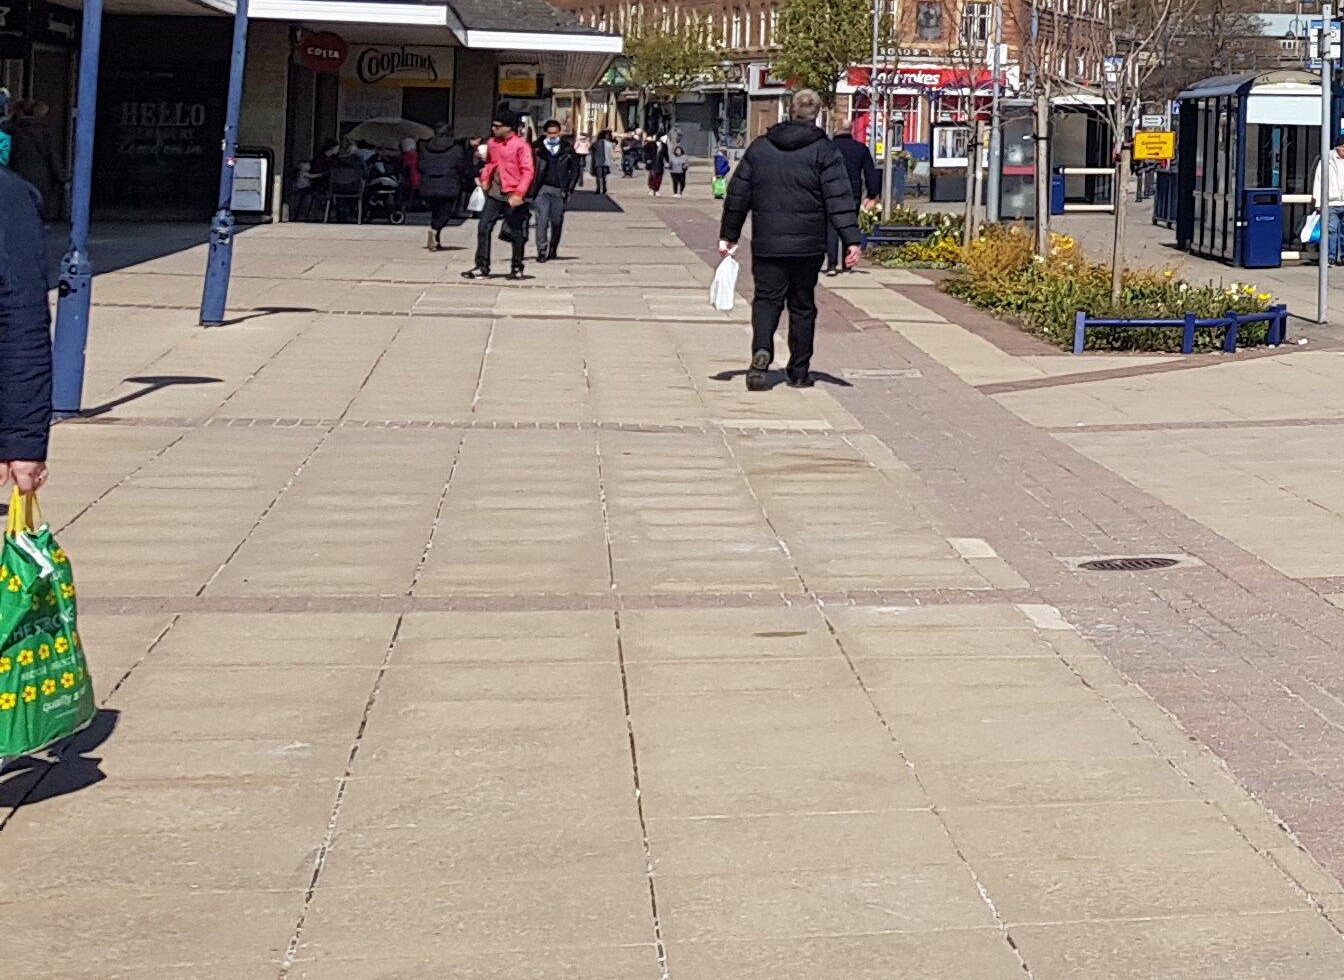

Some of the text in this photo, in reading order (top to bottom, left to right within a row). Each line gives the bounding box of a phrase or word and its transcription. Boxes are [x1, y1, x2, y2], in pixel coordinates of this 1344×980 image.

[306, 46, 340, 59] COSTA
[872, 70, 940, 85] adbrokes
[121, 101, 206, 127] HELLO
